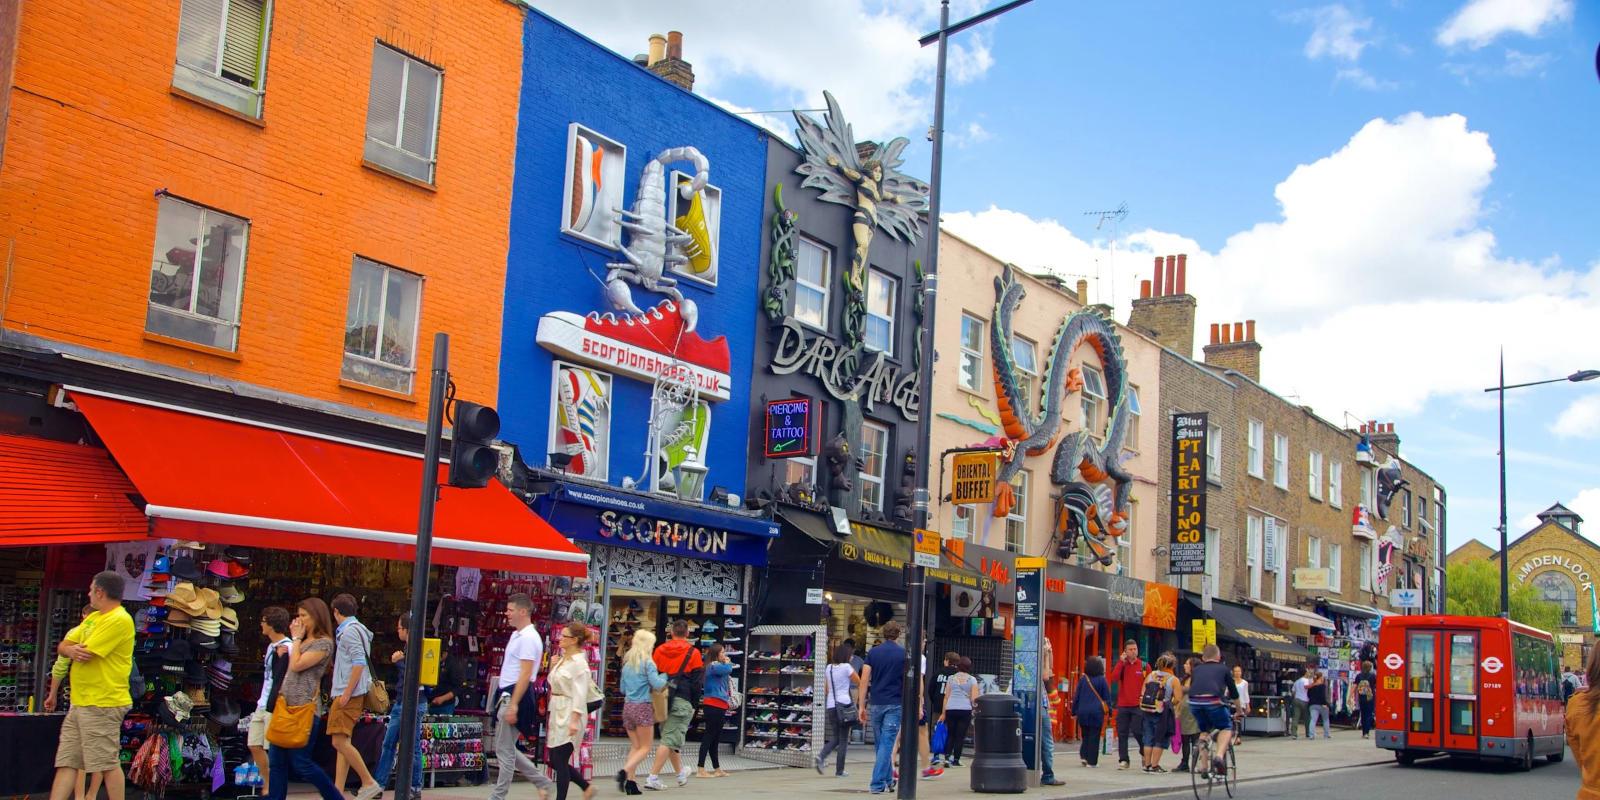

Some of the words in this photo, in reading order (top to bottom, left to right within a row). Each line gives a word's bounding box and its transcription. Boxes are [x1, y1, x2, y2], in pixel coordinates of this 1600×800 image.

[770, 315, 856, 400] DARK
[769, 402, 808, 415] PIERCING
[784, 415, 792, 426] &
[1176, 416, 1203, 427] Blue
[772, 427, 804, 439] TATTOO
[1176, 428, 1204, 440] Skin
[957, 463, 991, 479] ORIENTAL
[956, 480, 990, 499] BUFFET
[1177, 440, 1191, 543] PIERCING
[1189, 440, 1201, 543] TATTOO
[568, 489, 645, 511] www.scorpionshoes.co.uk
[599, 510, 728, 554] SCORPION
[1563, 558, 1592, 592] LOCK
